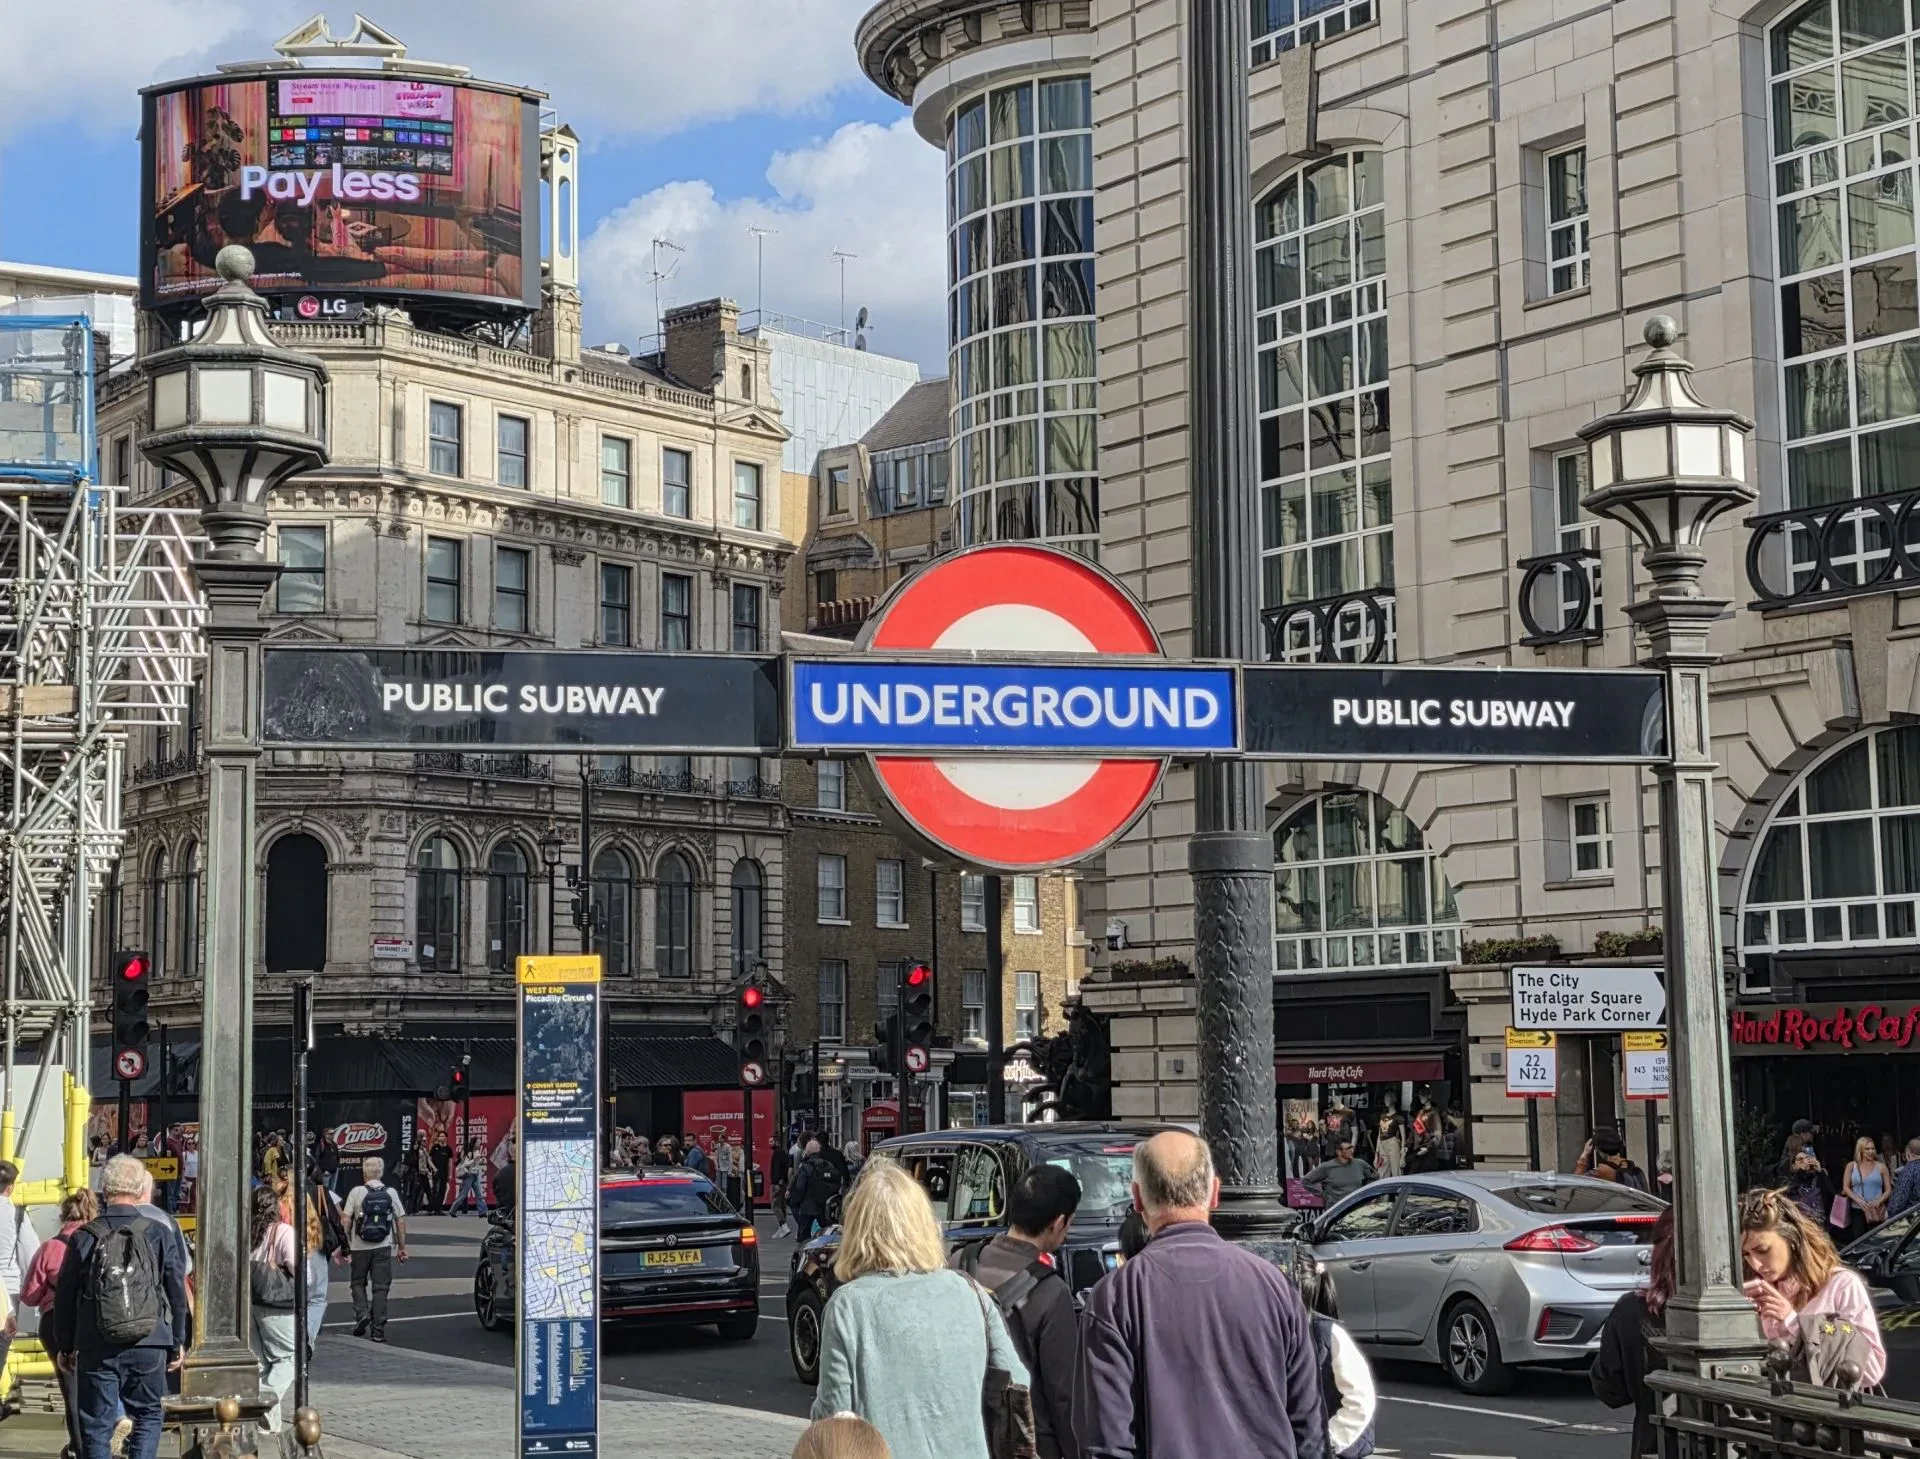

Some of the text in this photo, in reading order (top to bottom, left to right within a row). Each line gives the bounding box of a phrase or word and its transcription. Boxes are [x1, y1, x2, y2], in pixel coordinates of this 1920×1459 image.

[240, 163, 420, 205] Pay less
[322, 299, 347, 314] LG
[383, 683, 665, 715] PUBLIC SUBWAY
[811, 682, 1219, 728] UNDERGROUND
[1333, 698, 1576, 727] PUBLIC SUBWAY
[1518, 973, 1579, 990] The City
[526, 986, 565, 994] WEST END
[525, 994, 586, 1003] Piccadilly Circus
[1518, 991, 1643, 1007] Trafalgar Square
[1520, 1008, 1651, 1024] Hyde Park Corner
[1731, 1009, 1781, 1044] Hard
[1784, 1007, 1853, 1049] Rock
[1524, 1054, 1540, 1067] 22
[1308, 1065, 1364, 1080] Hard Rock Cafe
[1519, 1067, 1547, 1080] N22
[1634, 1066, 1646, 1074] N3
[401, 1115, 412, 1151] CANE'S
[647, 1250, 700, 1264] RJ25 YFA
